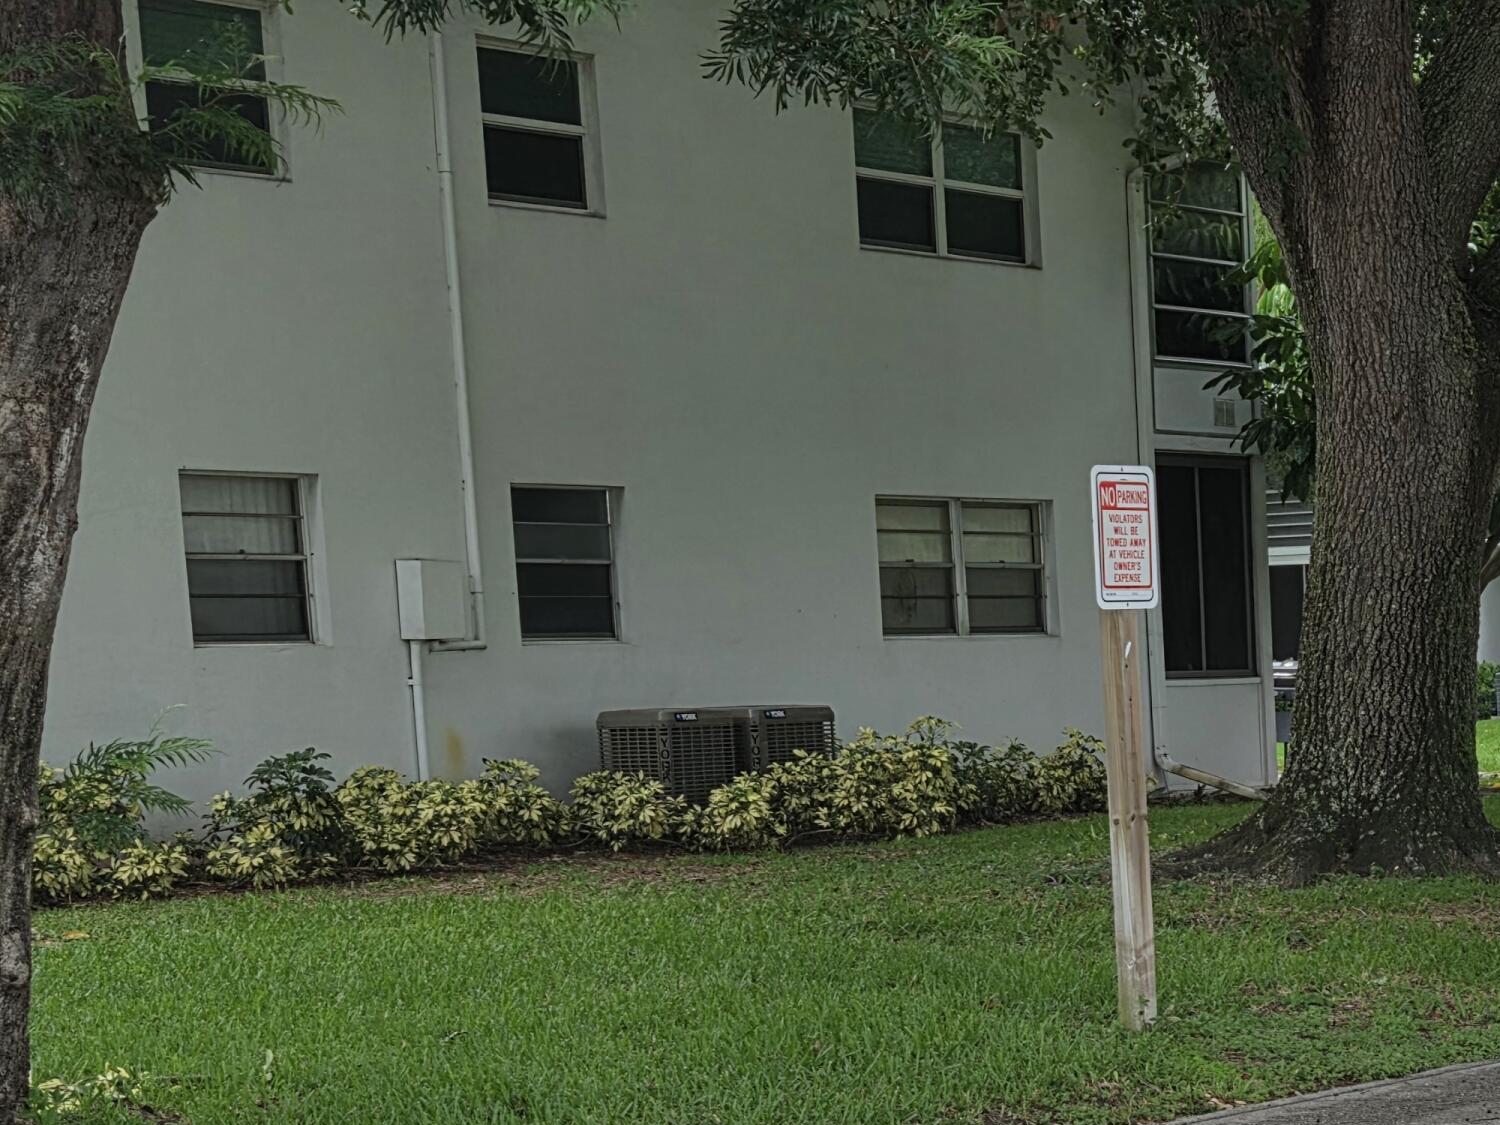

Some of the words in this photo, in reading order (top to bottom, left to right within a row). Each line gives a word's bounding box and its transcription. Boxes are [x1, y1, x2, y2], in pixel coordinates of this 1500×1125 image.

[1101, 487, 1116, 506] NO
[1117, 490, 1147, 504] PARKING
[1109, 514, 1143, 524] VIOLATORS
[1113, 527, 1128, 536] WILL
[1130, 527, 1139, 536] BE
[1106, 538, 1128, 547] TOWED
[1130, 538, 1146, 547] AWAY
[1109, 550, 1118, 559] AT
[1119, 550, 1145, 559] VEHICLE
[1113, 562, 1142, 571] OWNER'S
[1113, 574, 1142, 583] EXPENSE
[660, 737, 671, 783] YORK
